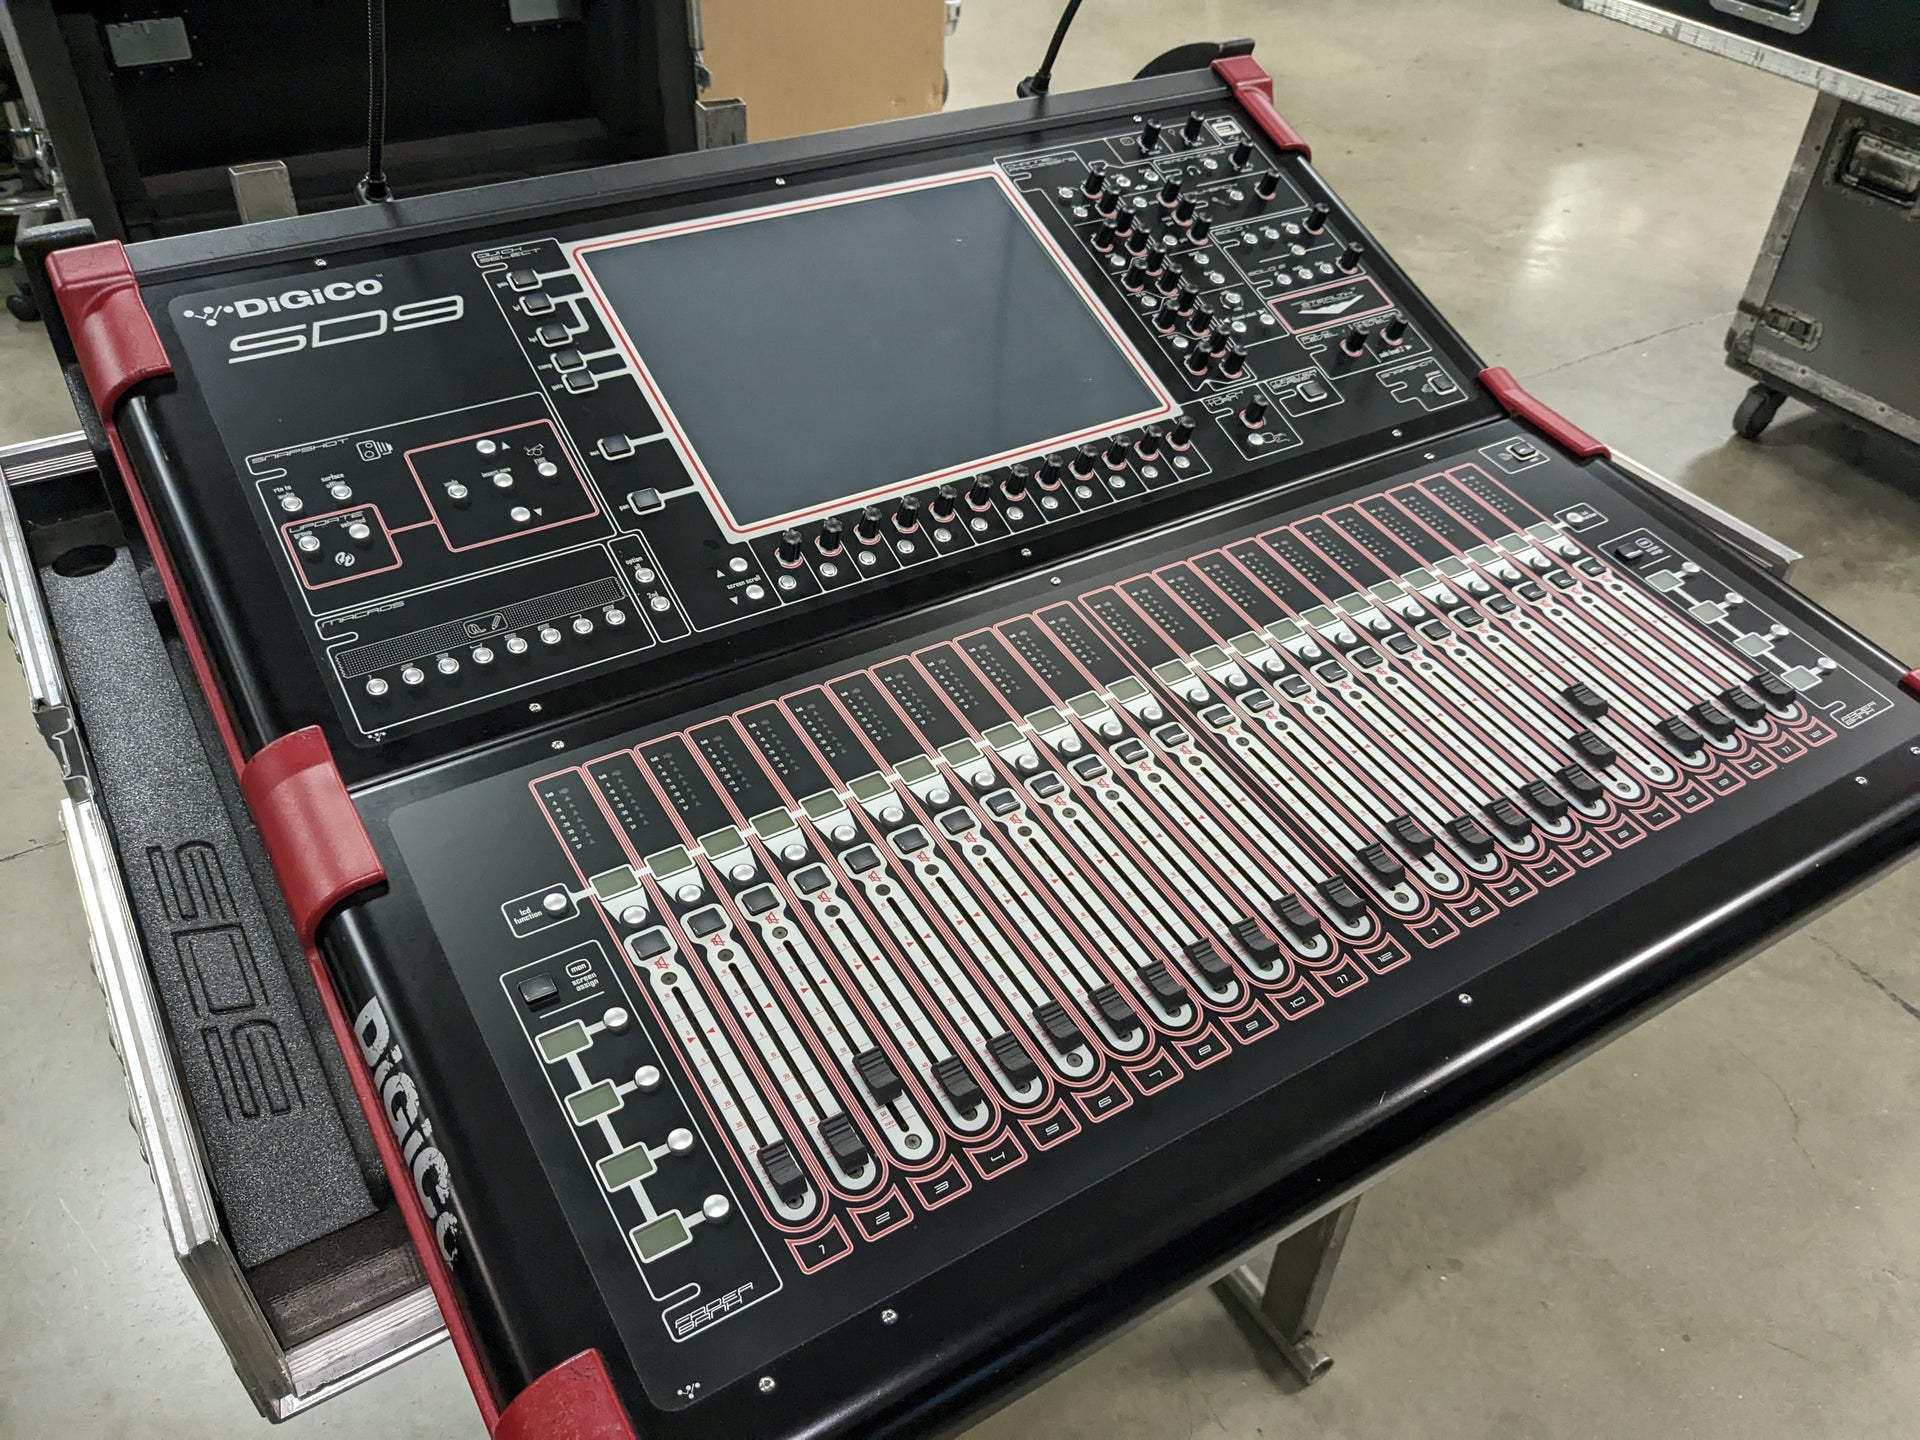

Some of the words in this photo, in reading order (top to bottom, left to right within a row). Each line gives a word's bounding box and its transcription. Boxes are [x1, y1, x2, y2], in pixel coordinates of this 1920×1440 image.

[480, 247, 541, 263] SELECT
[234, 278, 383, 319] DiGiCo
[229, 294, 464, 364] SD9
[252, 437, 349, 465] SNAPSHOT
[320, 472, 345, 483] surface
[289, 510, 364, 534] UPDATE
[625, 555, 644, 566] option
[727, 579, 747, 591] screen
[321, 600, 405, 629] MACROS
[1508, 886, 1520, 896] 3
[519, 906, 531, 917] lcd
[1470, 906, 1481, 916] 2
[513, 909, 543, 926] function
[1378, 951, 1393, 962] 12
[571, 972, 597, 987] screen
[575, 978, 600, 992] assign
[1336, 974, 1349, 984] 11
[1290, 996, 1305, 1008] 10
[1246, 1020, 1259, 1032] 9
[1199, 1043, 1212, 1055] 8
[1099, 1095, 1112, 1108] 6
[1046, 1123, 1060, 1135] 5
[935, 1181, 949, 1194] 3
[876, 1212, 890, 1224] 2
[819, 1244, 826, 1255] 1
[675, 1282, 753, 1329] FADER
[678, 1295, 743, 1336] BANK
